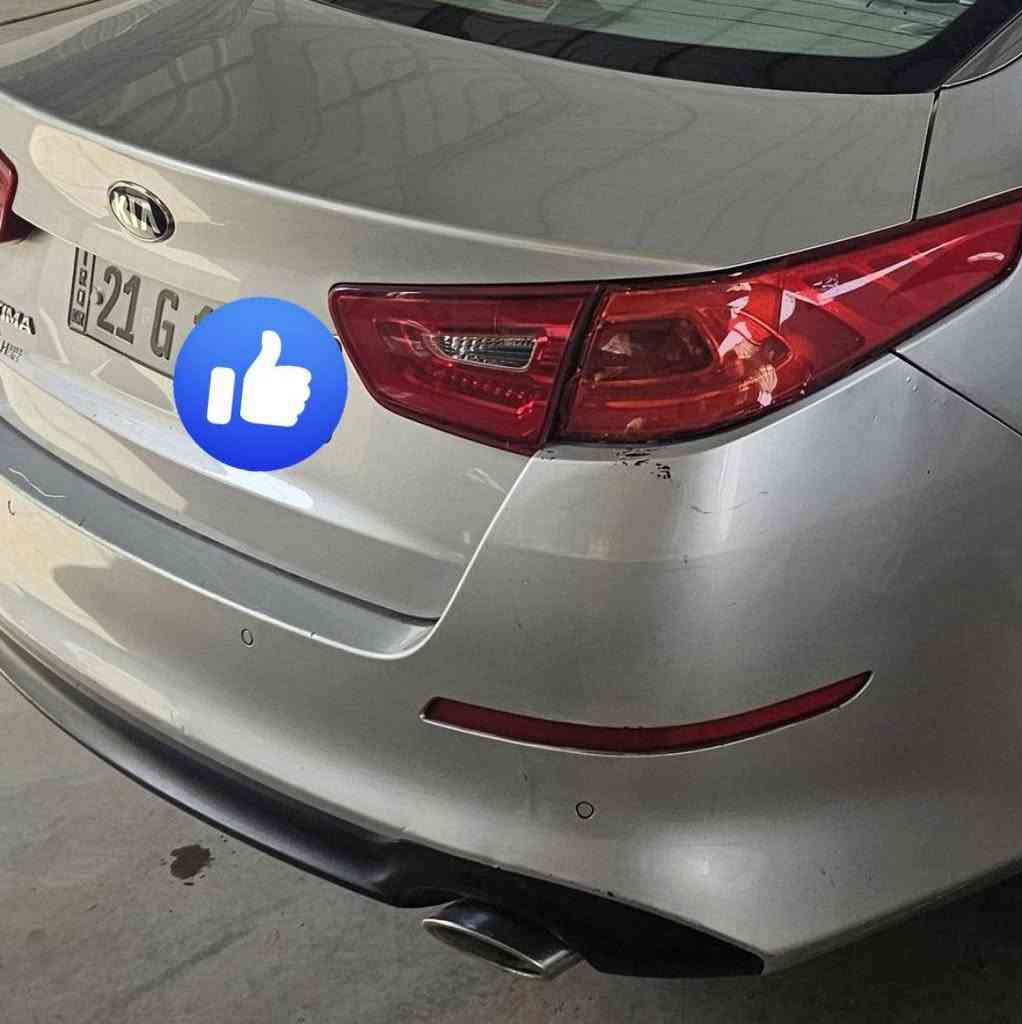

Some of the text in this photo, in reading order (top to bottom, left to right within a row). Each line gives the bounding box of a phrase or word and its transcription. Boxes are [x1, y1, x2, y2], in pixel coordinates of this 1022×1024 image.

[111, 190, 161, 234] KIA
[96, 265, 179, 361] 21 G
